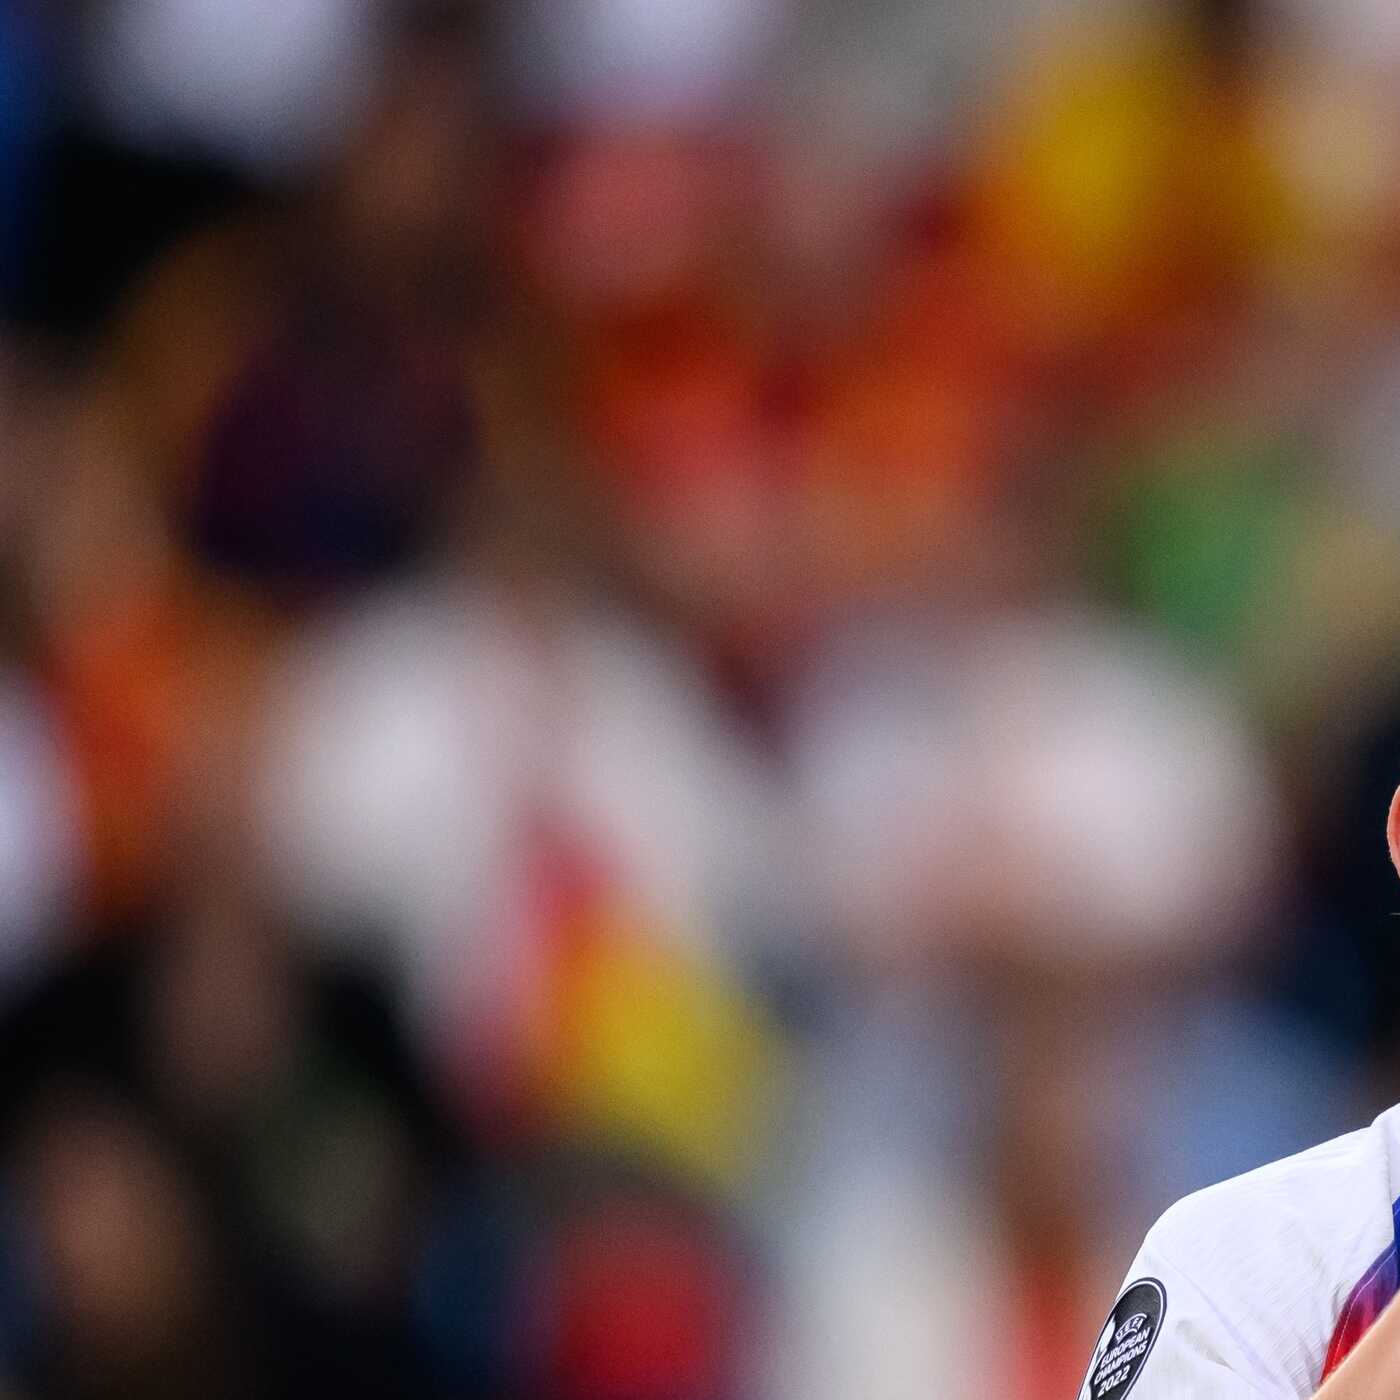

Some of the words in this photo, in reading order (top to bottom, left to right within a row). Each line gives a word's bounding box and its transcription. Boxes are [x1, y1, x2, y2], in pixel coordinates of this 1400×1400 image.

[1094, 1340, 1148, 1386] CHAMPIONS
[1100, 1326, 1152, 1368] EUROPEAN
[1097, 1364, 1131, 1398] 2022
